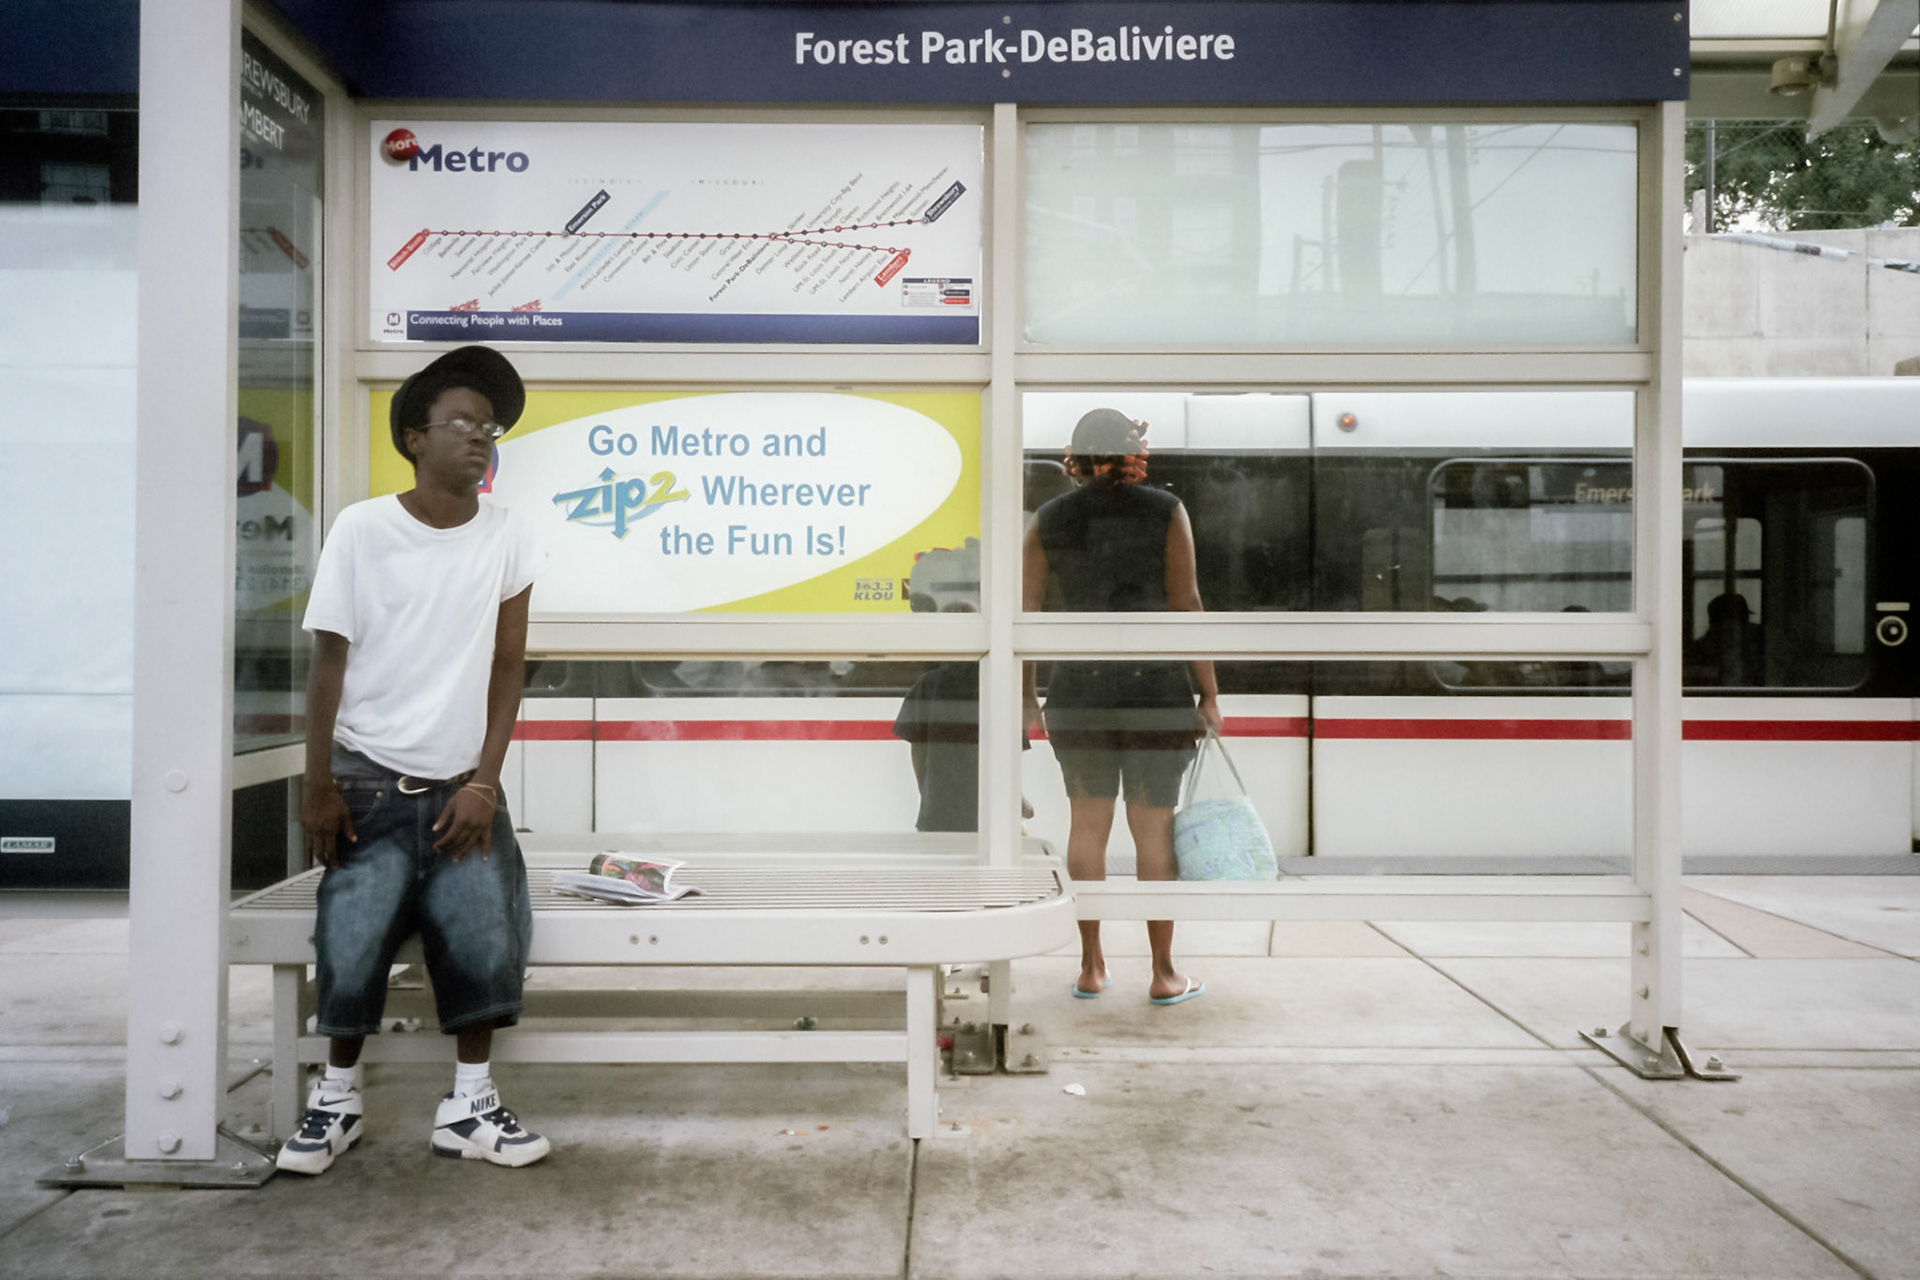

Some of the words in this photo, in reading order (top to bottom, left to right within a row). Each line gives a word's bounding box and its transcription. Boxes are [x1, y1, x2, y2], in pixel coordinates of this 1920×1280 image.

[795, 31, 910, 65] Forest
[921, 25, 1236, 64] Park-DeBaliviere
[242, 50, 310, 124] REWSBURY
[408, 143, 530, 173] Metro
[566, 206, 594, 232] Emerson
[591, 193, 608, 210] Park
[926, 184, 960, 217] Shrewsbury
[388, 234, 424, 269] Shiloh-Scott
[708, 282, 728, 303] Forest
[725, 241, 771, 286] Park-DeBaliviere
[410, 313, 469, 328] Connecting
[470, 314, 505, 328] People
[507, 315, 530, 326] with
[532, 315, 563, 327] Places
[587, 424, 639, 457] Go
[650, 425, 750, 457] Metro
[761, 426, 827, 458] and
[700, 475, 872, 507] Wherever
[1574, 482, 1634, 503] Emers
[1682, 482, 1716, 503] ark
[659, 525, 715, 556] the
[727, 525, 793, 556] Fun
[805, 525, 847, 556] Is!
[853, 591, 895, 601] KLOU
[5, 841, 49, 850] LAMAR
[470, 1093, 497, 1114] NIKE
